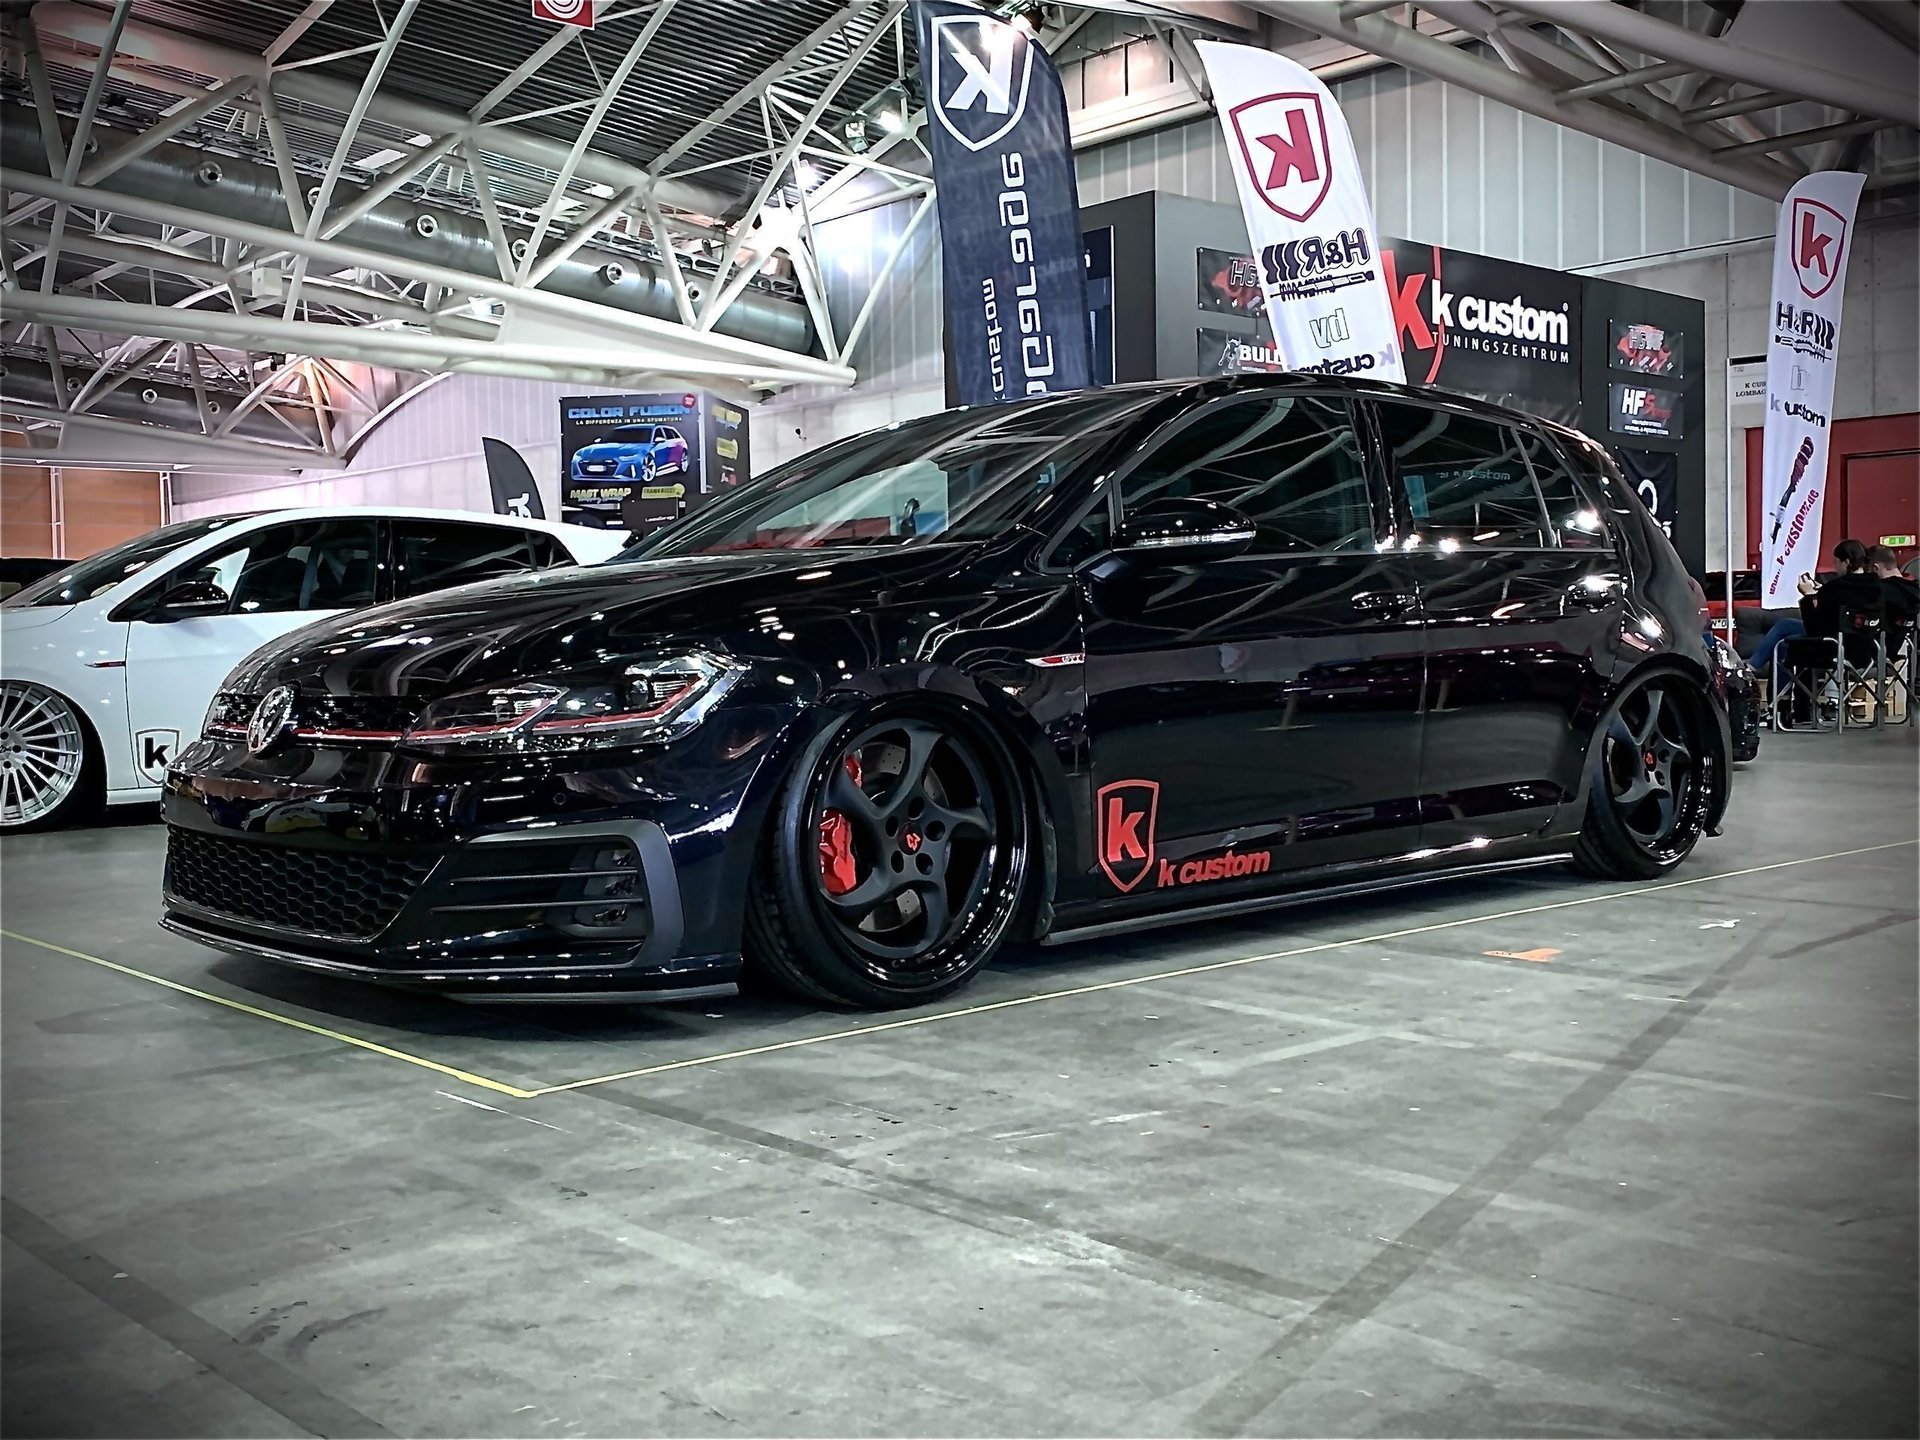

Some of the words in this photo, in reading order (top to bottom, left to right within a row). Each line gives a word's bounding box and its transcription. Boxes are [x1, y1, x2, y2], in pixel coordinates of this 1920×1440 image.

[1800, 211, 1833, 278] k
[1229, 260, 1262, 288] HG
[1458, 295, 1569, 345] custom
[1432, 331, 1569, 364] TUNINGSZENTRUM
[1735, 389, 1767, 397] LOMBAG
[568, 406, 623, 419] COLOR
[144, 737, 171, 769] k
[1107, 797, 1147, 863] k
[1157, 858, 1177, 888] k
[1179, 850, 1271, 884] custom
